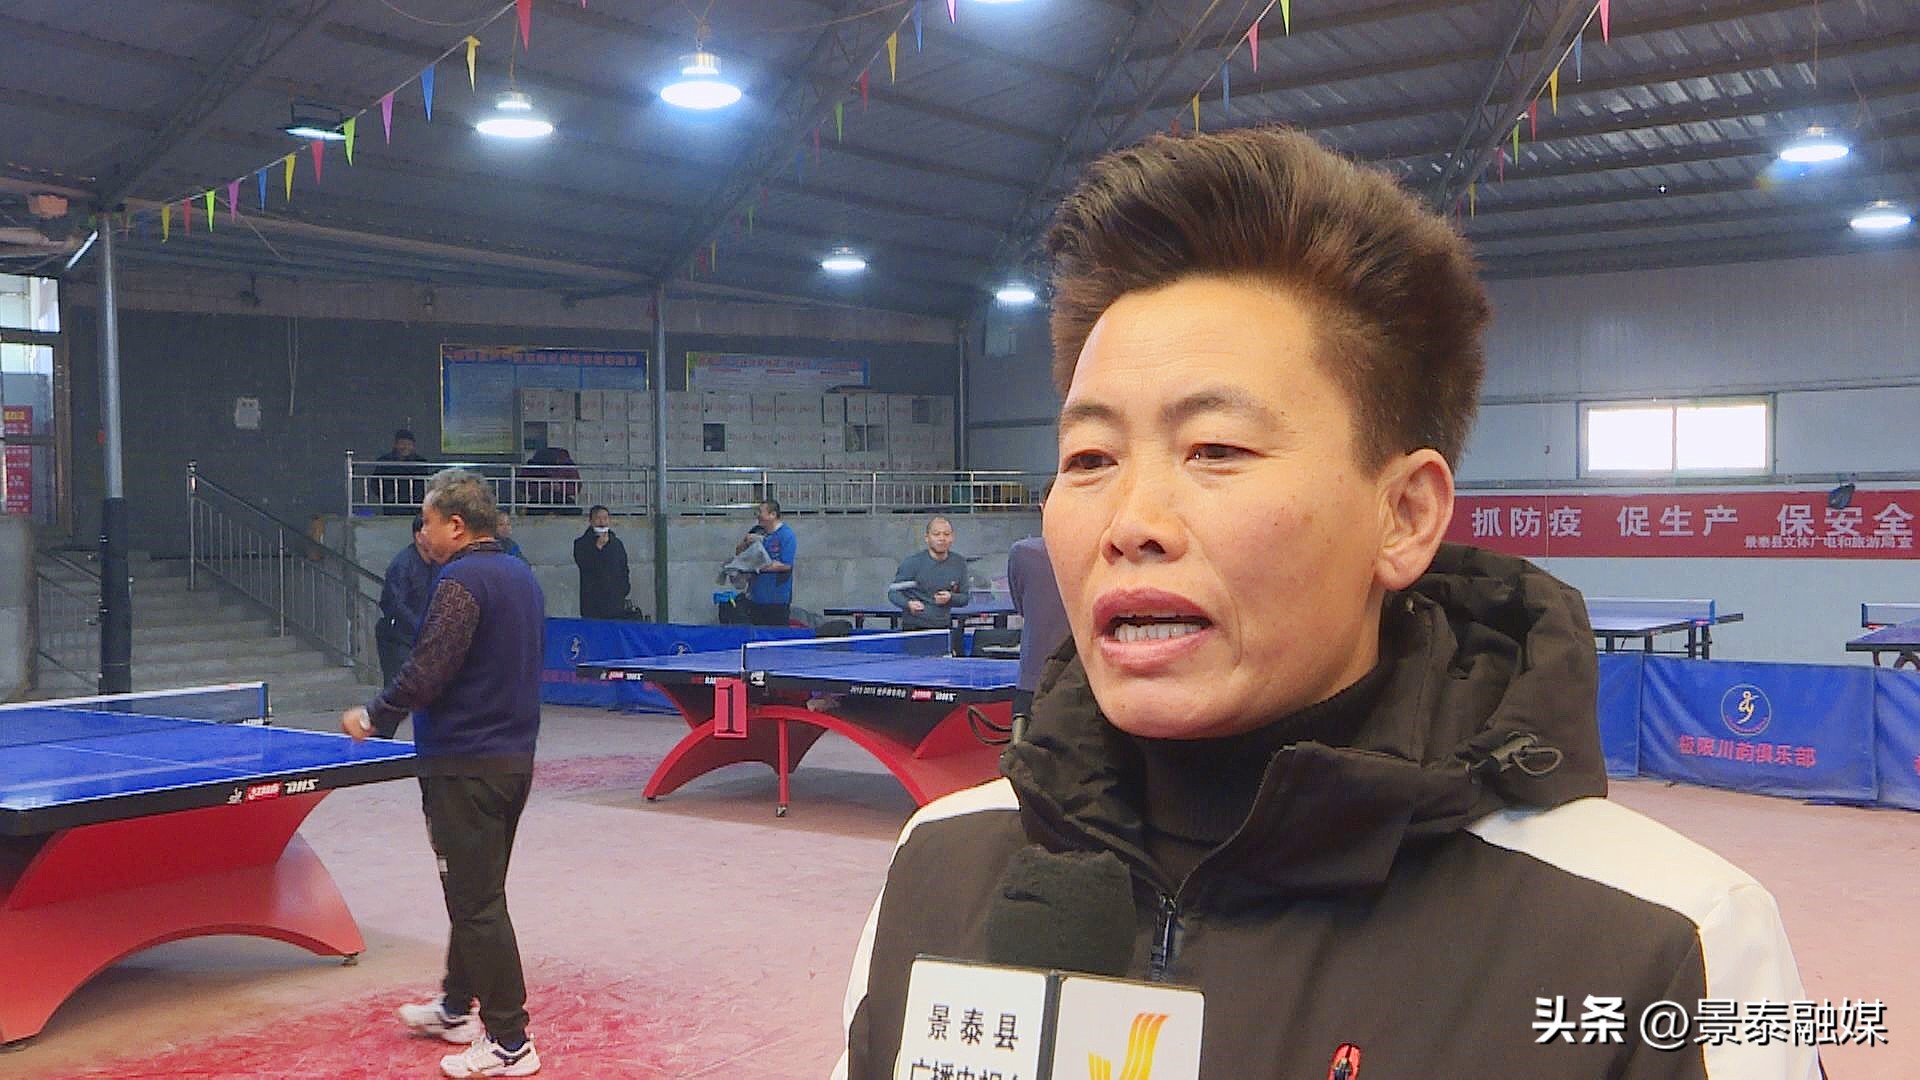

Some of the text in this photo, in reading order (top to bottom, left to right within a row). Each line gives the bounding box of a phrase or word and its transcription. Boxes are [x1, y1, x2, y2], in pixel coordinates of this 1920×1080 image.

[1472, 502, 1913, 537] 抓防疫 促生产 保安全
[717, 684, 743, 734] 1
[285, 779, 319, 795] DHS
[928, 1002, 1019, 1051] 景泰县
